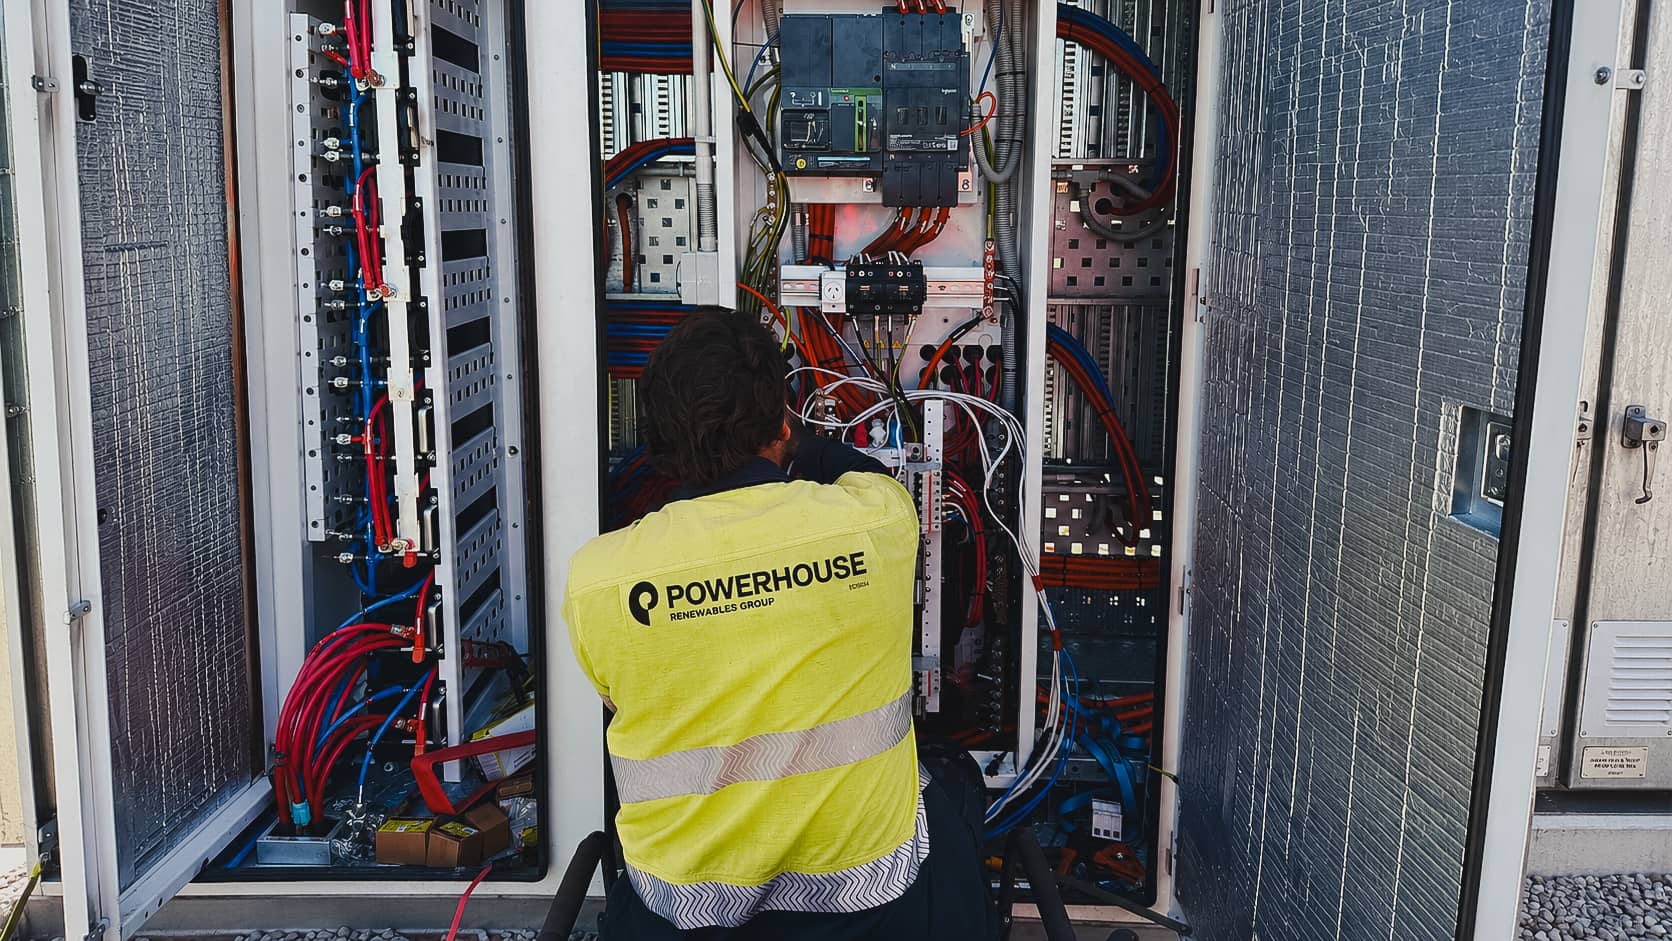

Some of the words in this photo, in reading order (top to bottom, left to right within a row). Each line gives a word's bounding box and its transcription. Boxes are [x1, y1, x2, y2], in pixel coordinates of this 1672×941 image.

[666, 551, 868, 609] POWERHOUSE
[670, 603, 738, 622] RENEWABLES
[740, 597, 775, 610] GROUP
